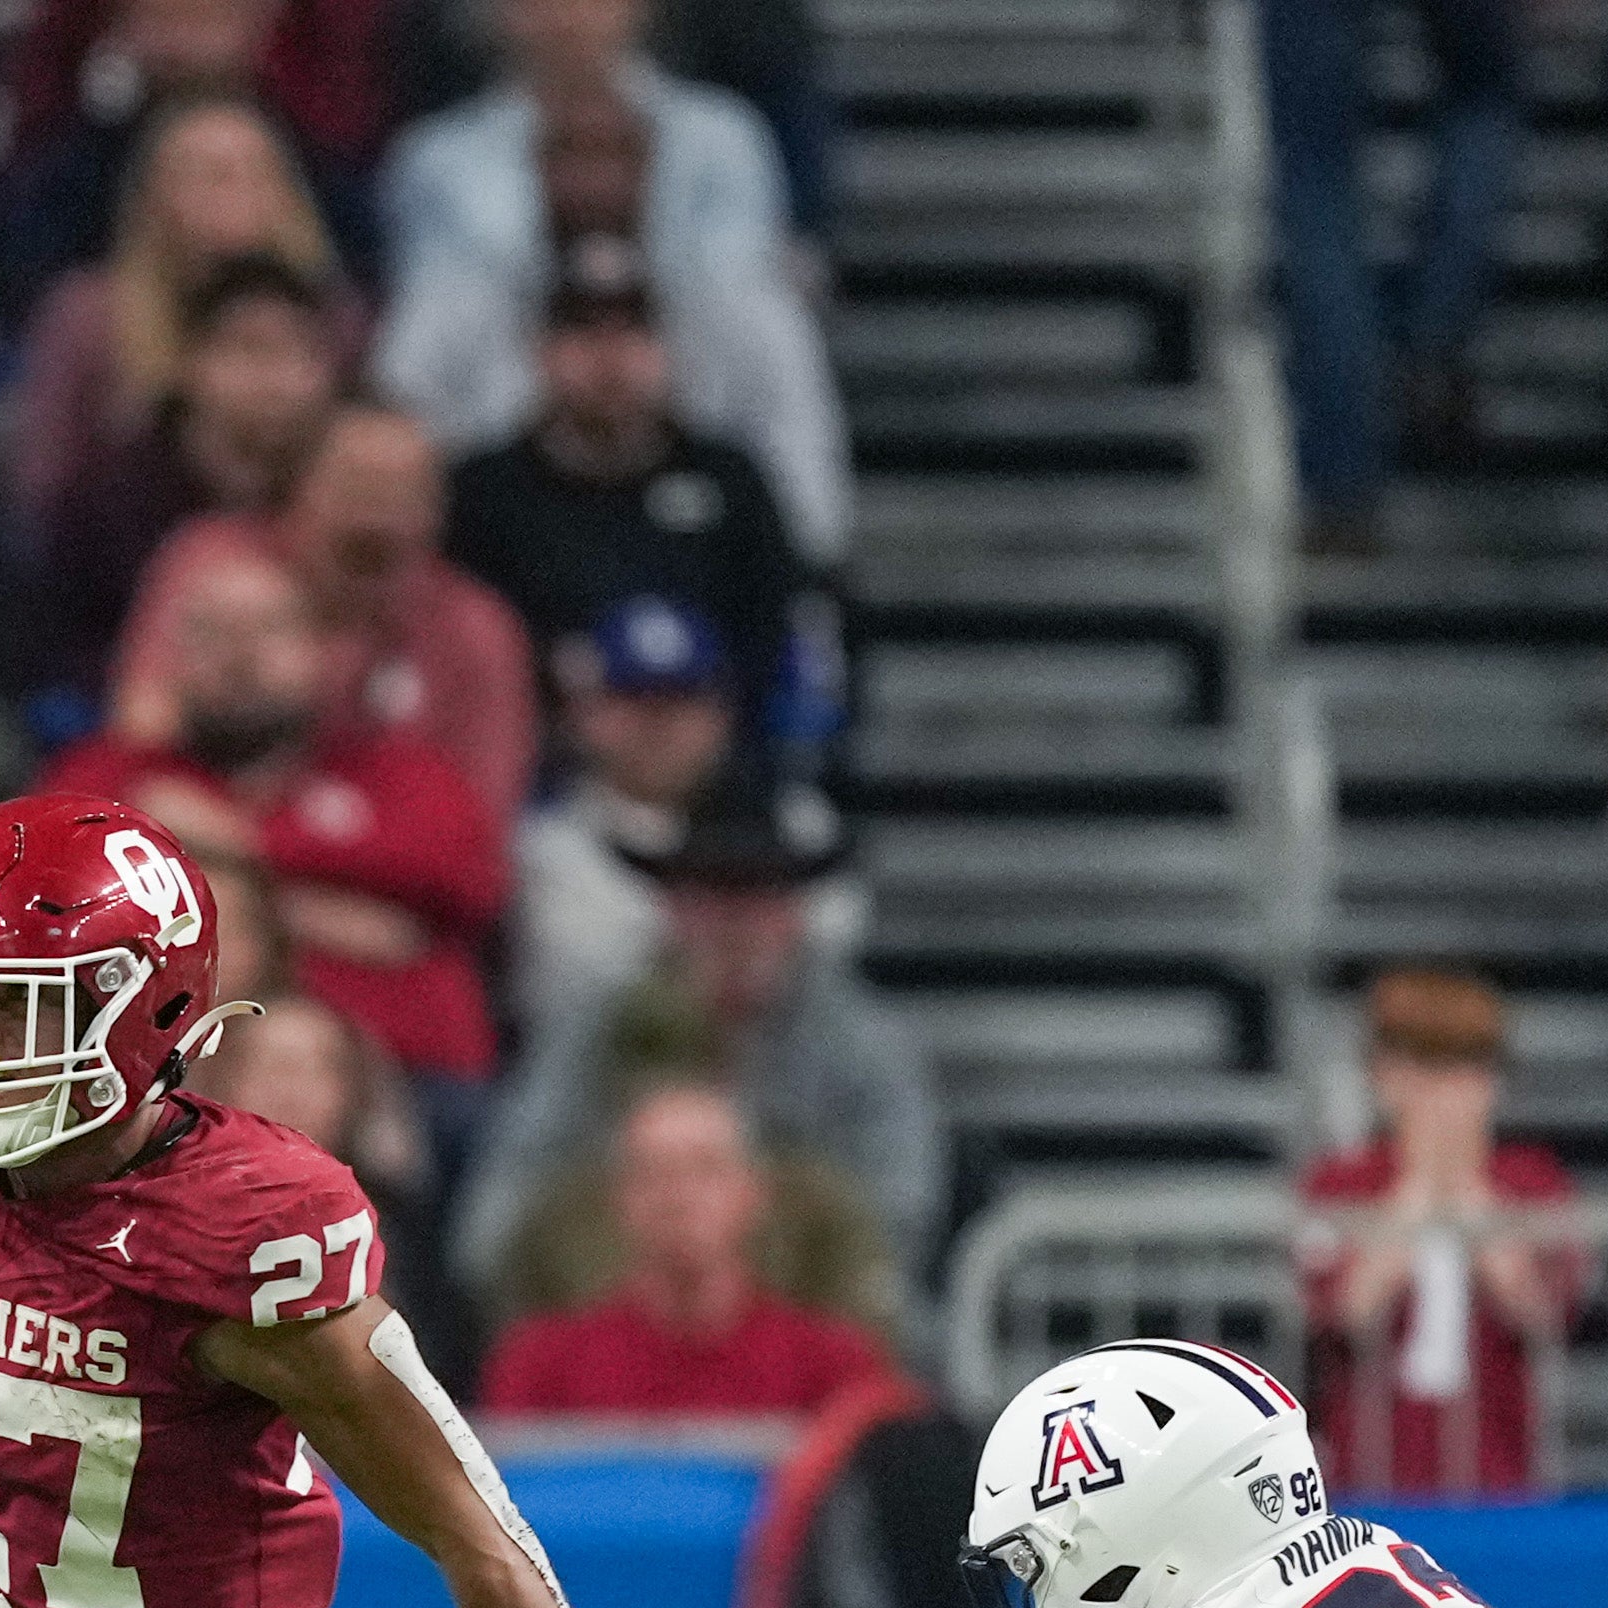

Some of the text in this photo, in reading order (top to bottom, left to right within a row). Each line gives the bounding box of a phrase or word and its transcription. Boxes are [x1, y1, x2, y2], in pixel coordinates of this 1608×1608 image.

[248, 1209, 377, 1328] 27
[1032, 1401, 1123, 1511] A
[1250, 1475, 1283, 1508] PAC
[1263, 1495, 1280, 1515] 12
[1289, 1467, 1322, 1517] 92
